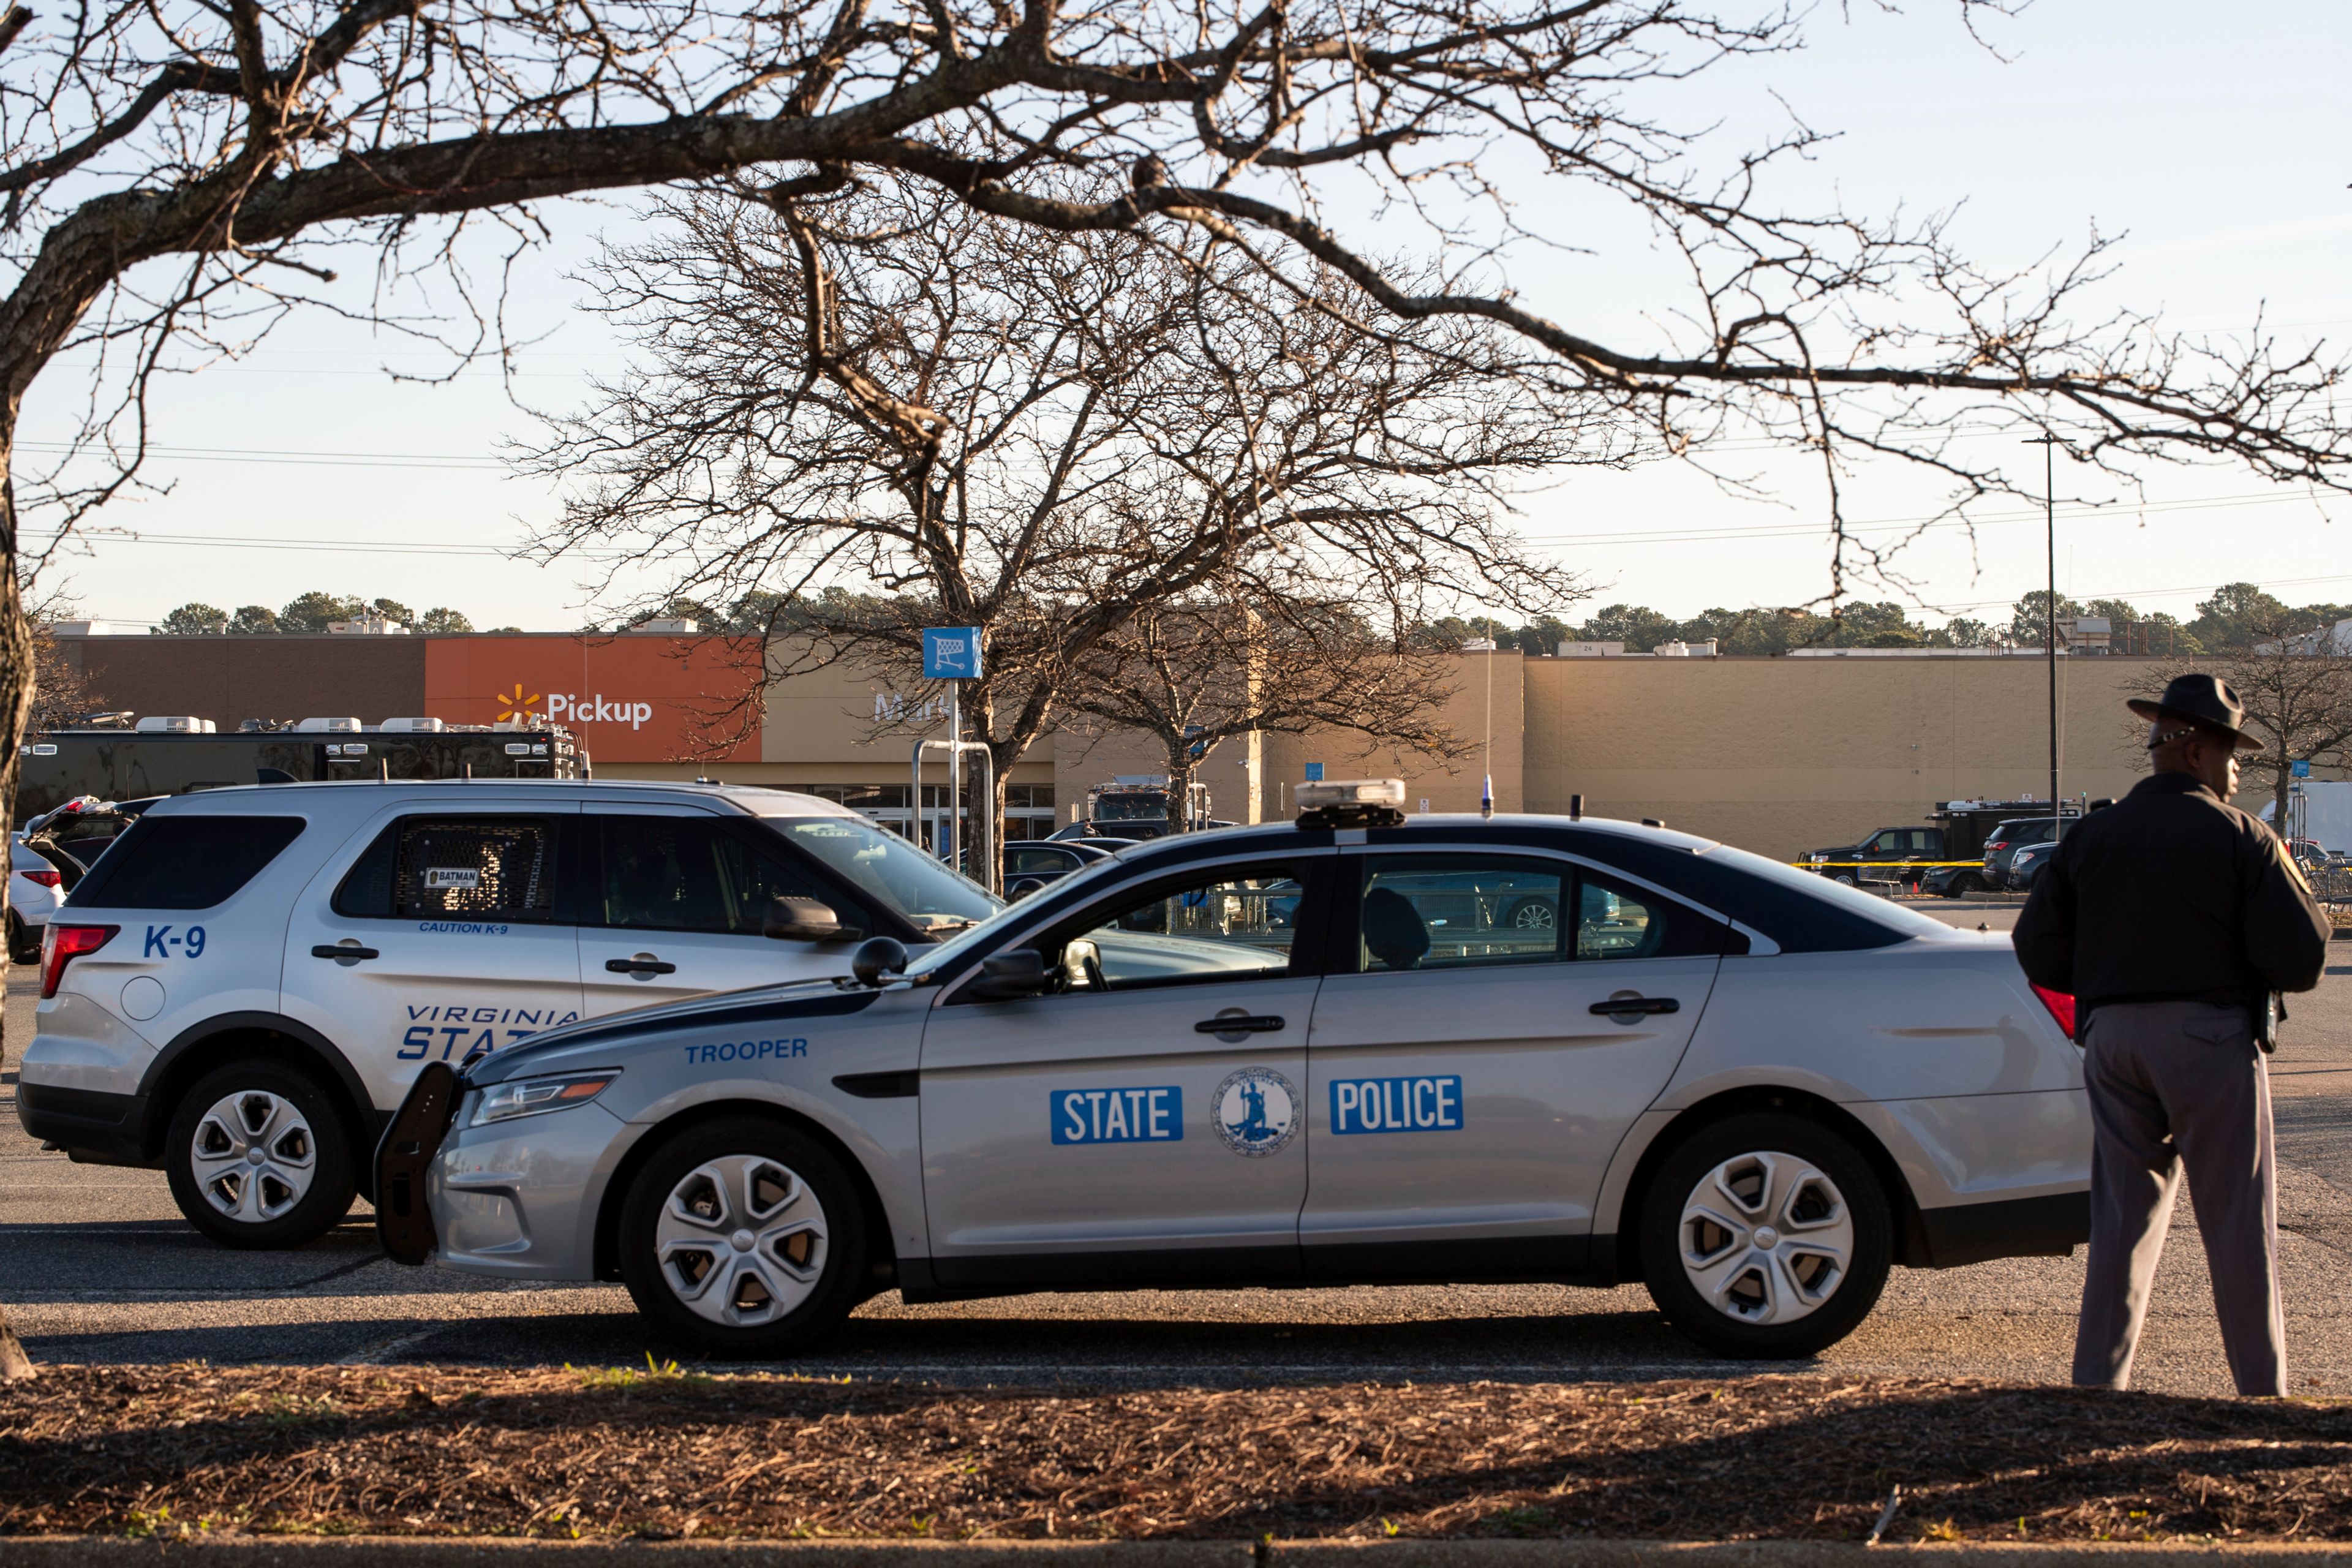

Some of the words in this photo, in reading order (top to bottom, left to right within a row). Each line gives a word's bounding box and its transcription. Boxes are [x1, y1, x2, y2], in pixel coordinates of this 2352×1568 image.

[548, 694, 652, 730] Pickup
[439, 872, 475, 881] BATMAN
[144, 925, 206, 959] K-9
[420, 922, 482, 933] CAUTION
[486, 925, 508, 935] K-9
[407, 1005, 579, 1025] VIRGINIA
[685, 1038, 807, 1064] TROOPER
[1064, 1090, 1169, 1140] STATE
[1337, 1079, 1456, 1130] POLICE
